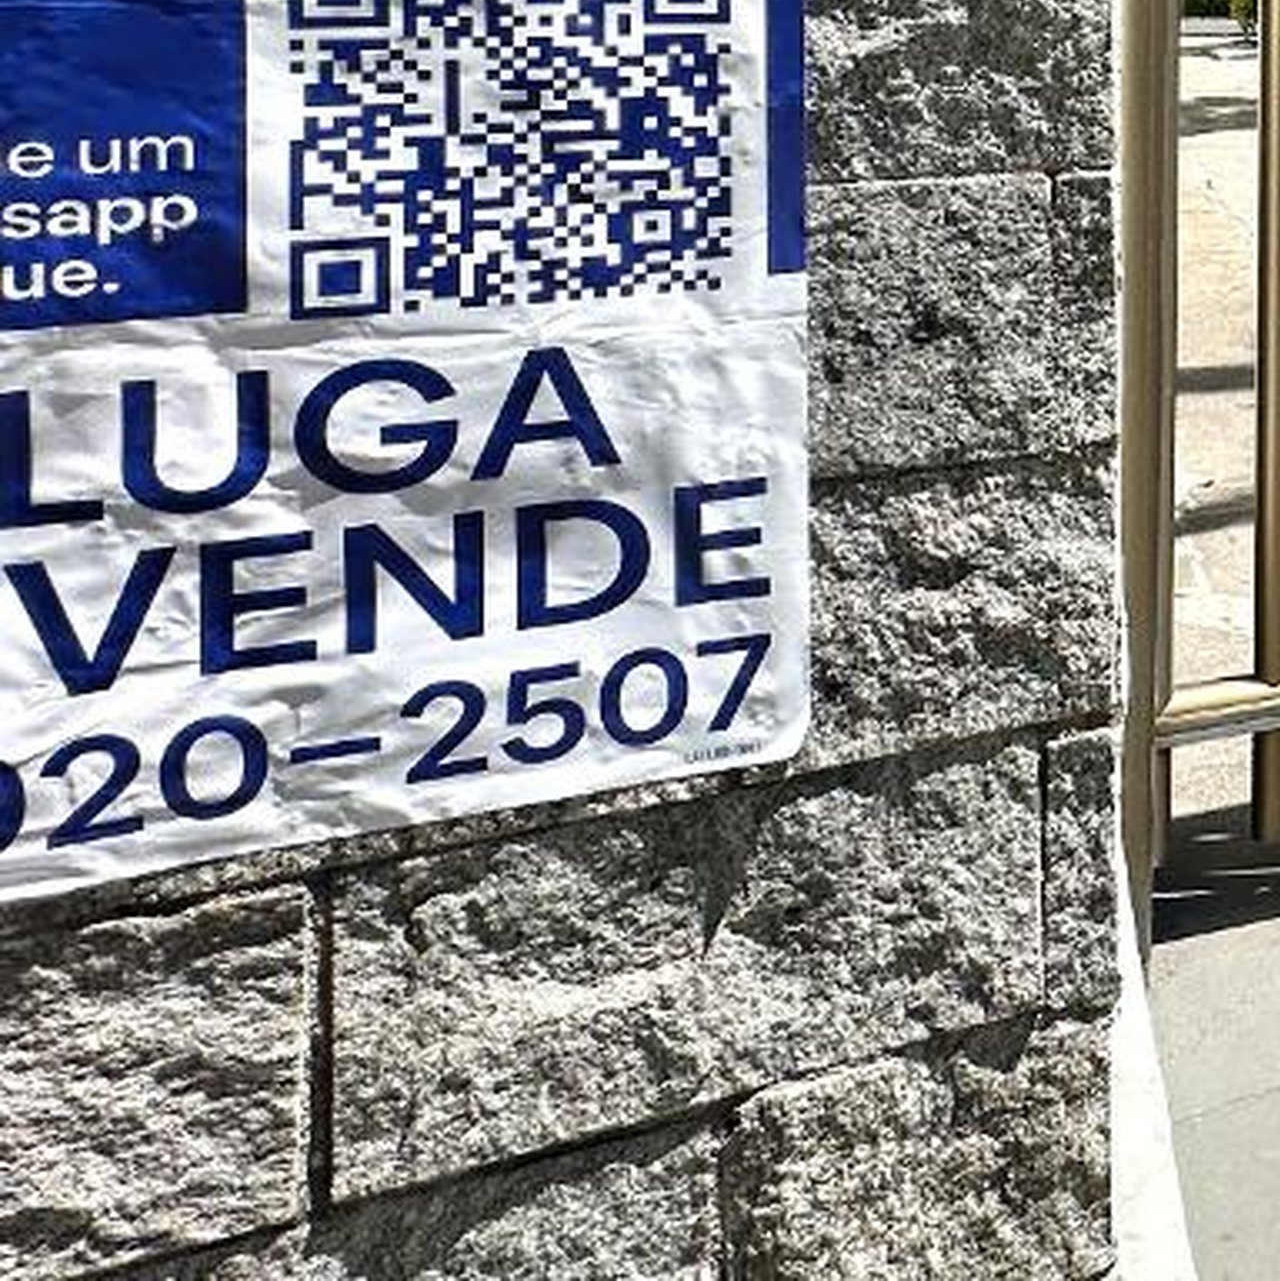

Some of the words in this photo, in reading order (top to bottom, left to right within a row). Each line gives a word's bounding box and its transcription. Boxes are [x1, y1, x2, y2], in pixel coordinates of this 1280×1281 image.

[7, 141, 55, 178] e
[78, 134, 195, 174] um
[2, 194, 198, 245] sapp
[2, 259, 120, 300] ue.
[0, 346, 622, 526] LUGA
[3, 476, 772, 696] VENDE
[0, 633, 773, 851] 20-2507
